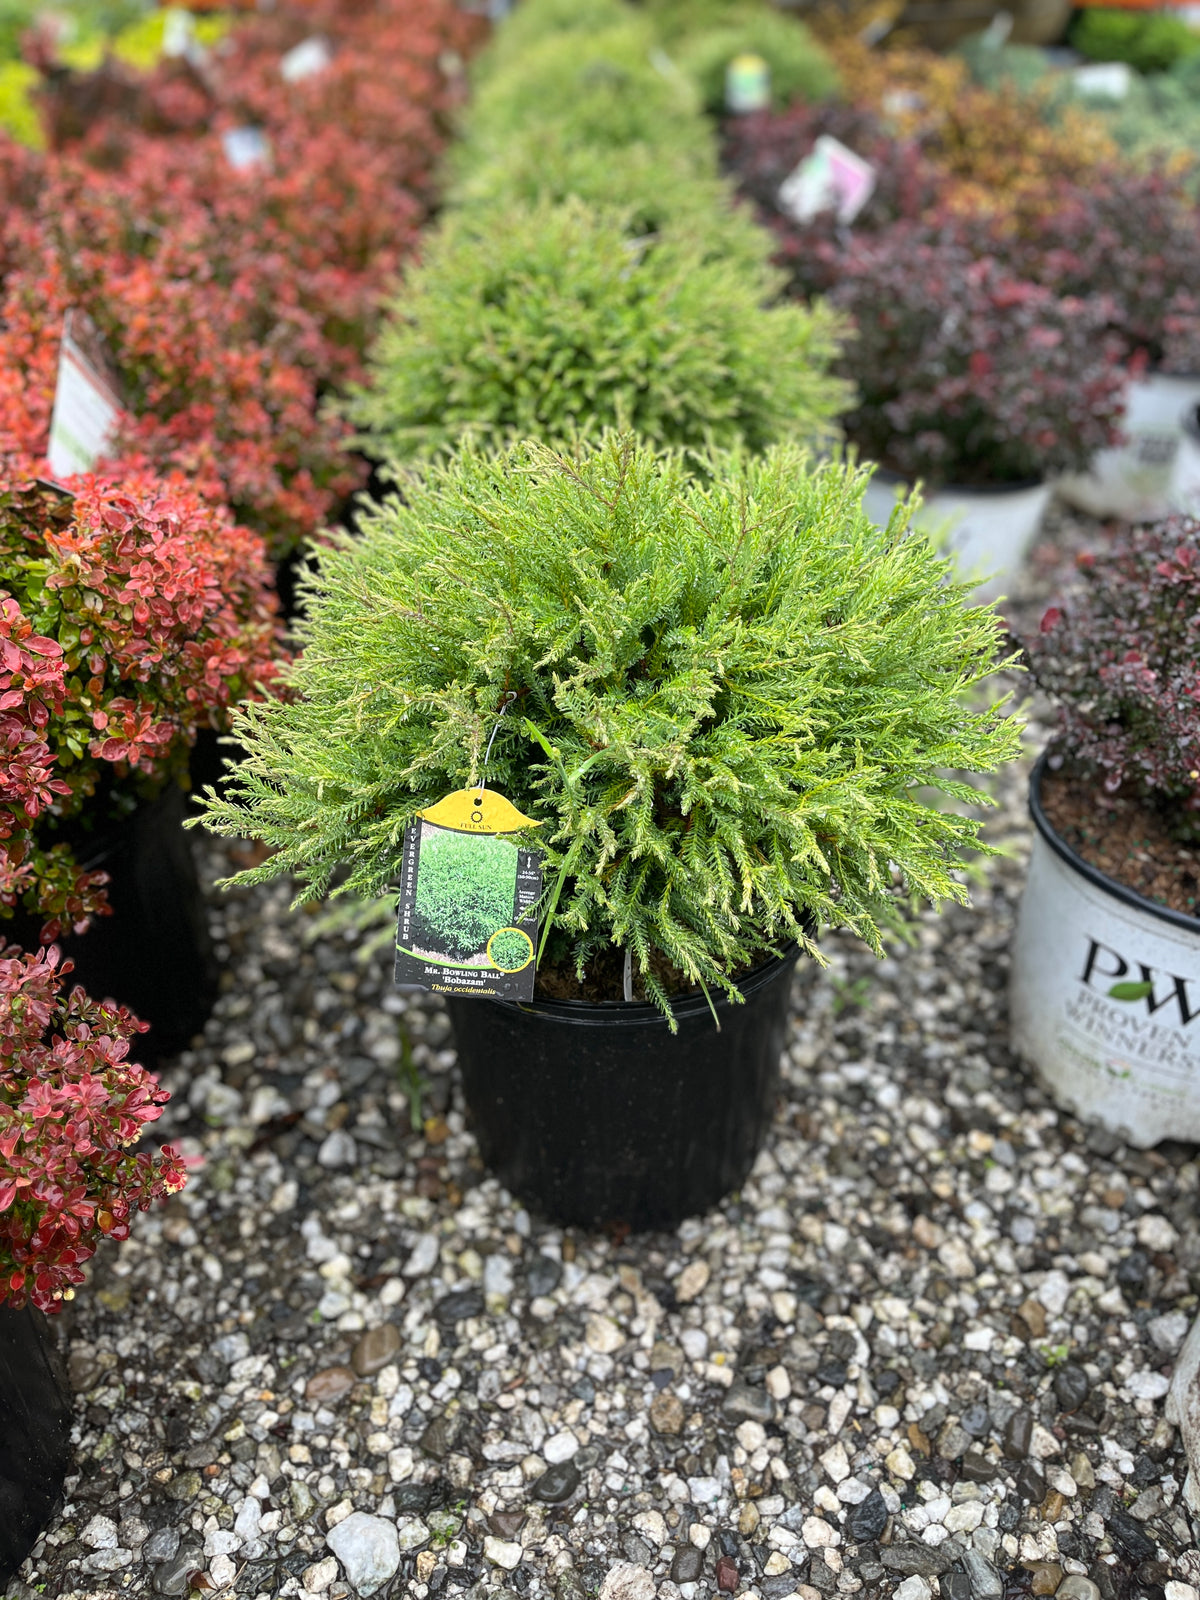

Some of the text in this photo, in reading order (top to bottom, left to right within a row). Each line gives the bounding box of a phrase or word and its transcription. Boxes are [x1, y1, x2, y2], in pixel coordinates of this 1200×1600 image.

[402, 827, 417, 940] EVERGREEN SHRUB
[431, 983, 496, 995] Thuja occidentalis
[442, 976, 486, 986] 'Bobazam'
[1064, 998, 1195, 1070] WINNERS
[1077, 989, 1193, 1048] PROVEN
